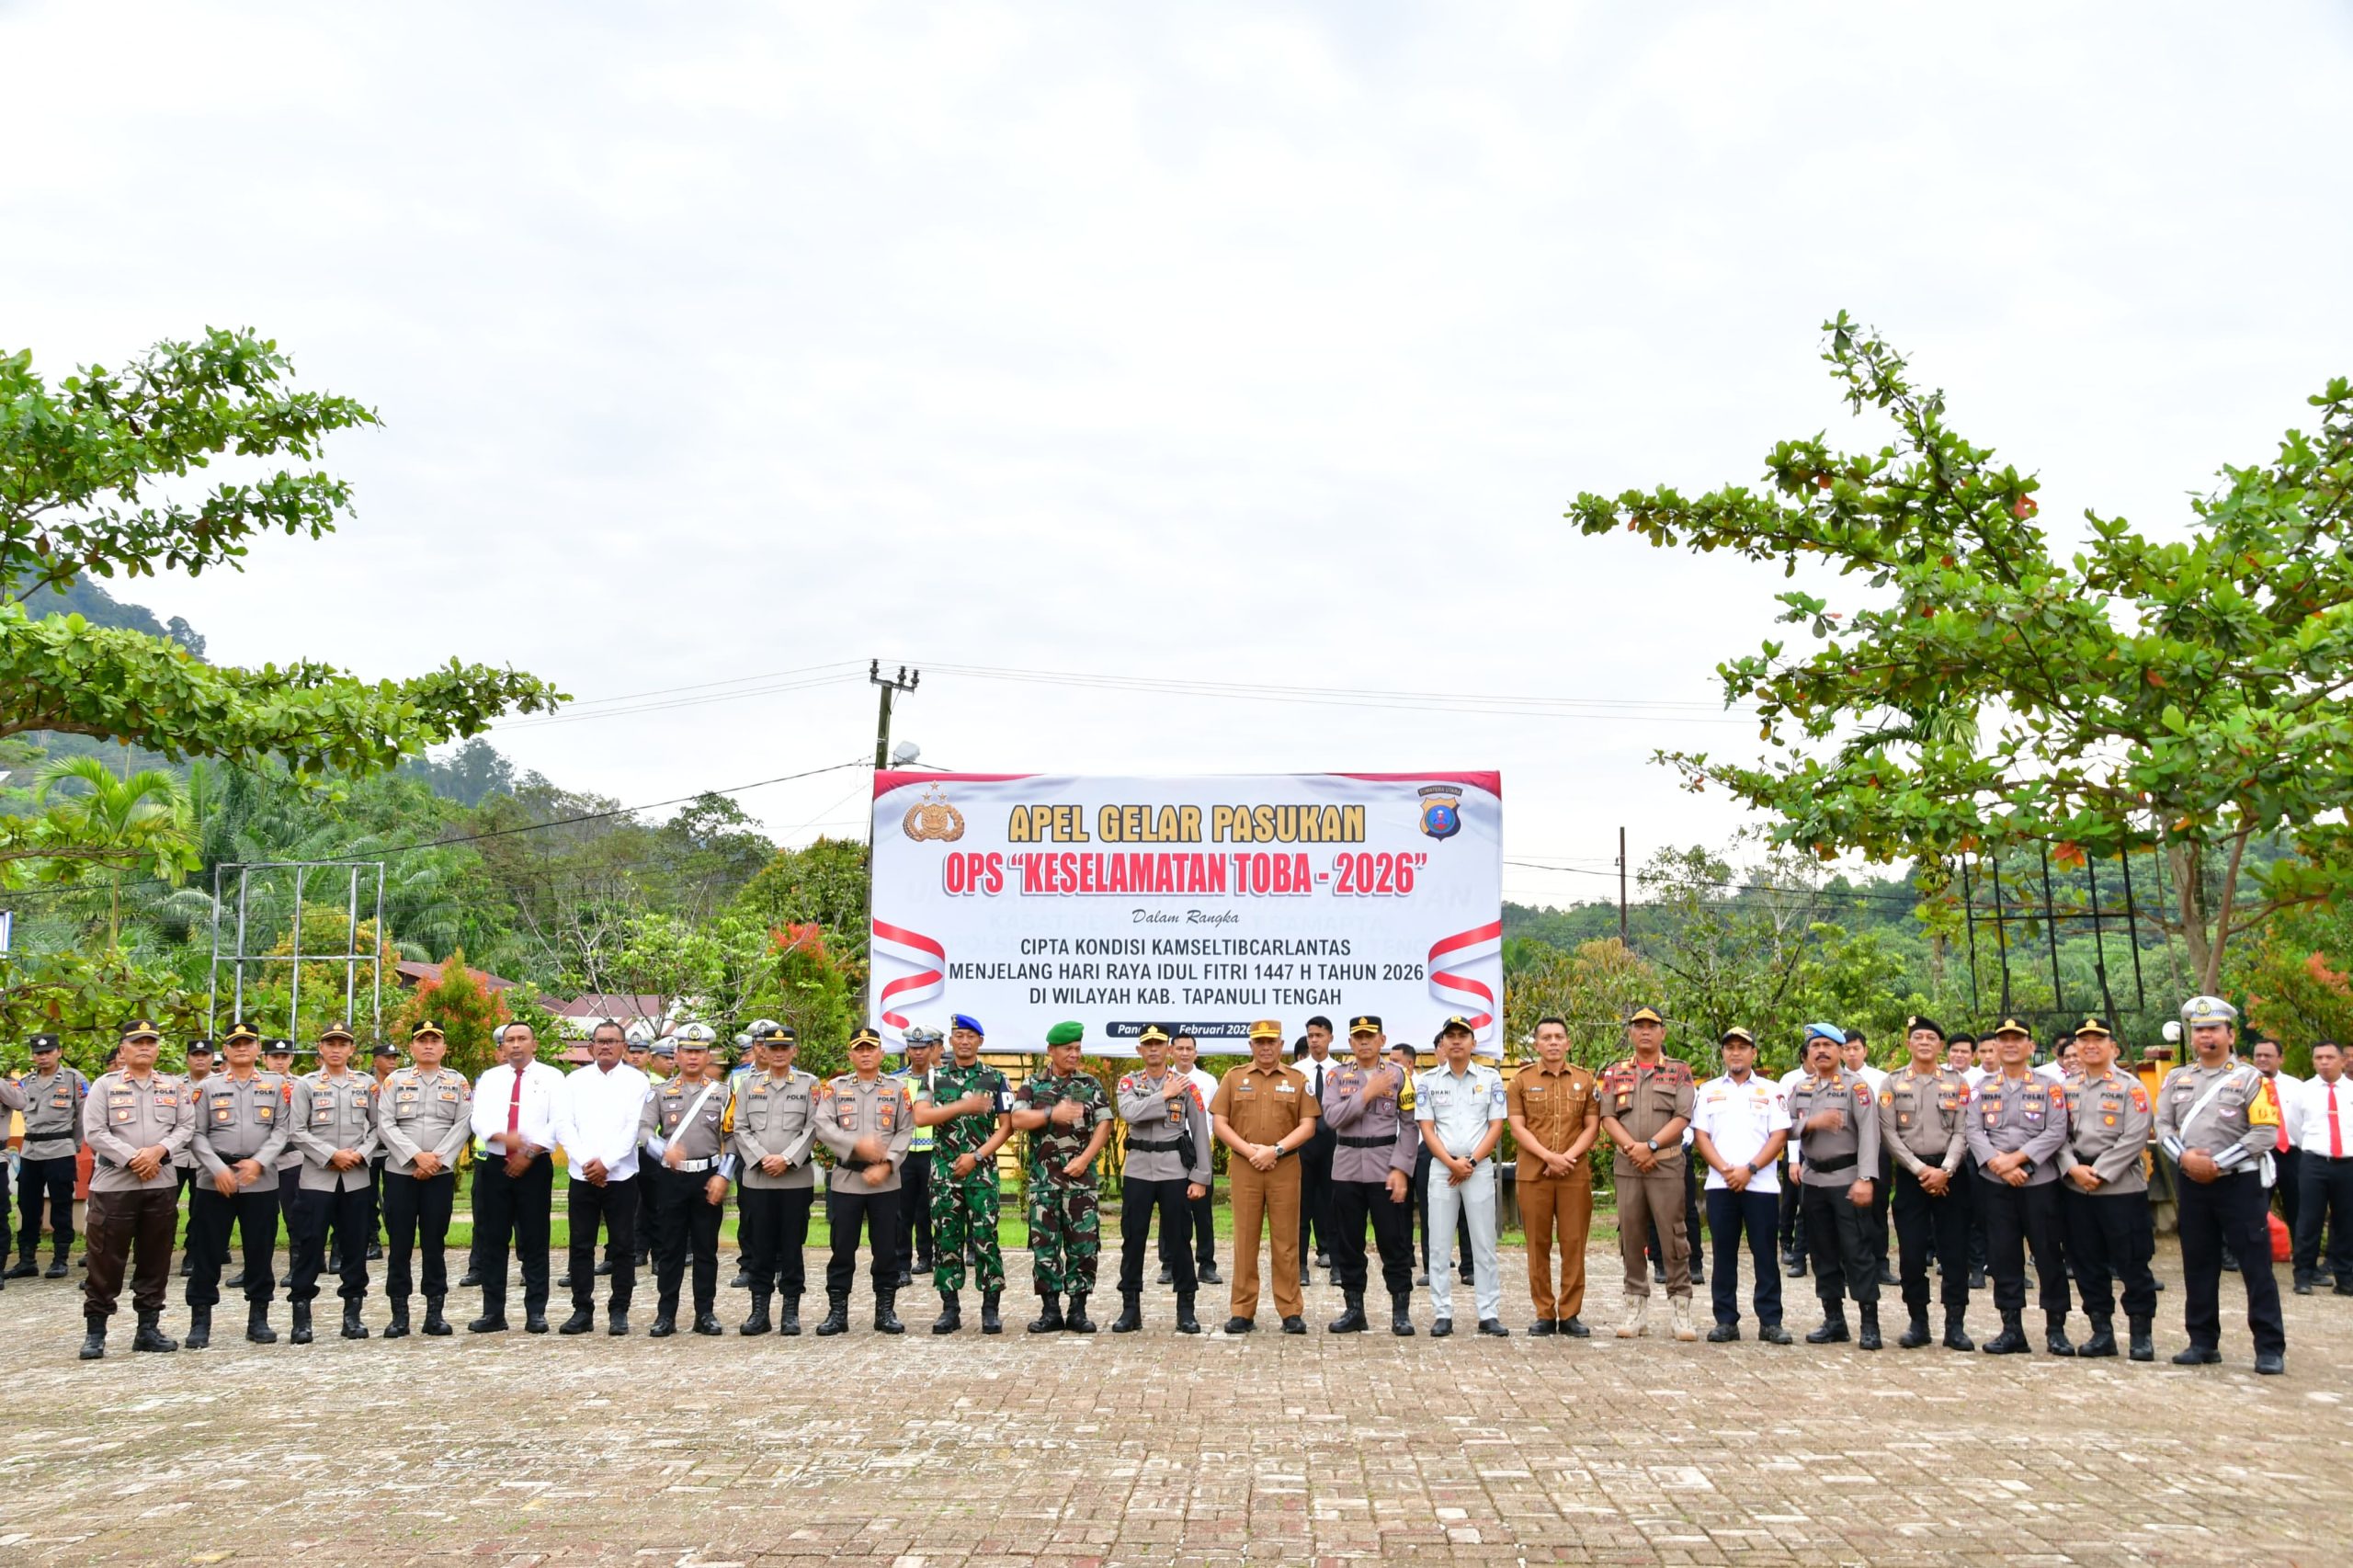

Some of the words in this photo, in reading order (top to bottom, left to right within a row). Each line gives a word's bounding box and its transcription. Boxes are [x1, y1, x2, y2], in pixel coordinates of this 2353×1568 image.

[1008, 804, 1090, 843] APEL
[1097, 804, 1202, 843] GELAR
[1212, 804, 1365, 843] PASUKAN
[942, 851, 1004, 897] OPS
[1230, 852, 1313, 897] TOBA
[1131, 908, 1179, 924] Dalam
[1186, 909, 1239, 928] Rangka
[1020, 938, 1070, 956] CIPTA
[1075, 938, 1145, 956] KONDISI
[1152, 938, 1351, 956] KAMSELTIBCARLANTAS
[949, 962, 1052, 980] MENJELANG
[1059, 963, 1099, 980] HARI
[1107, 963, 1152, 980] RAYA
[1157, 963, 1199, 980] IDUL
[1204, 963, 1247, 981] FITRI
[1253, 963, 1294, 981] 1447
[1301, 963, 1312, 981] H
[1317, 963, 1377, 981] TAHUN
[1382, 963, 1424, 981] 2026
[1029, 987, 1047, 1005] DI
[1052, 987, 1131, 1005] WILAYAH
[1137, 987, 1176, 1005] KAB.
[1182, 988, 1266, 1006] TAPANULI
[1271, 988, 1341, 1006] TENGAH
[1178, 1023, 1225, 1035] Februari
